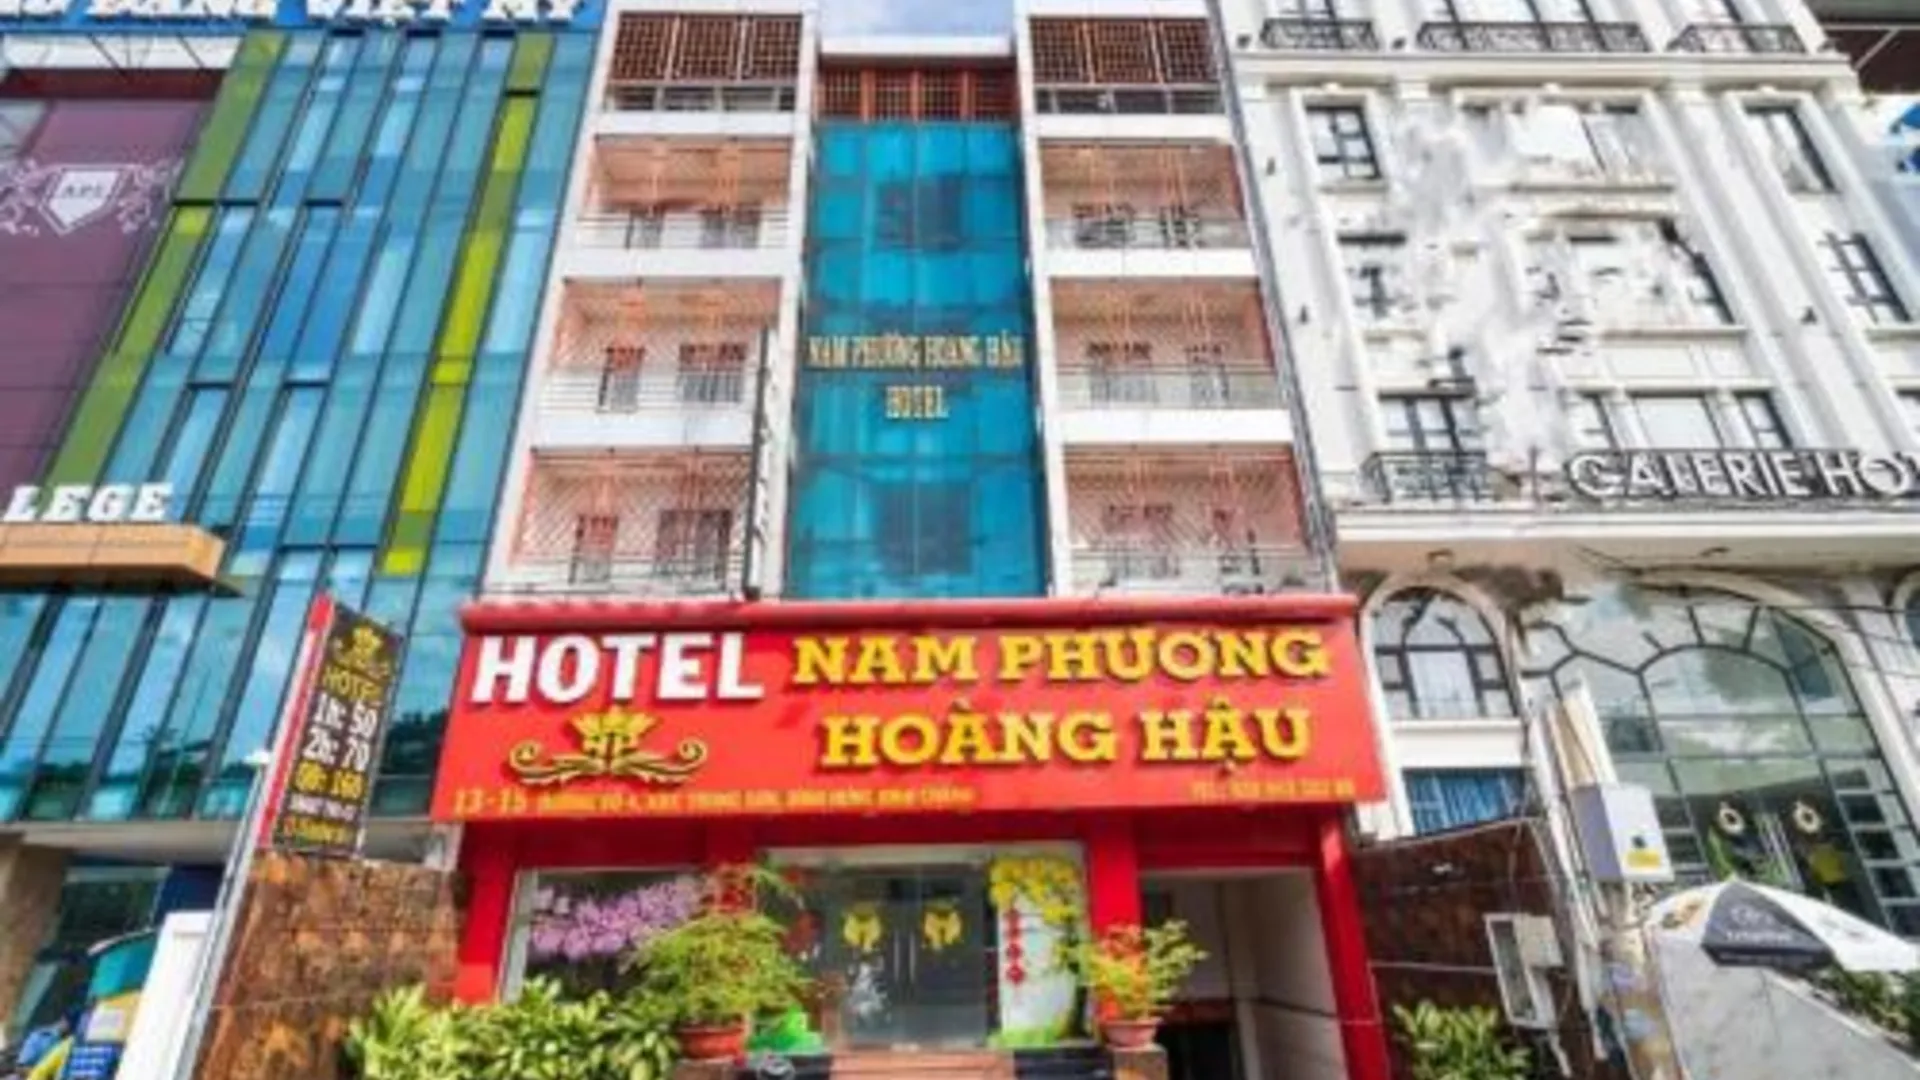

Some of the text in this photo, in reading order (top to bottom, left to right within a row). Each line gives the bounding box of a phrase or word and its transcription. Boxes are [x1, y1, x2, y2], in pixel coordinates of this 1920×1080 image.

[885, 384, 950, 419] HOTEL
[1568, 450, 1811, 497] GALERIE
[2, 483, 174, 521] LEGE
[471, 632, 764, 702] HOTEL
[792, 635, 978, 684] NAM
[821, 695, 1311, 771] HOÀNG HẬU
